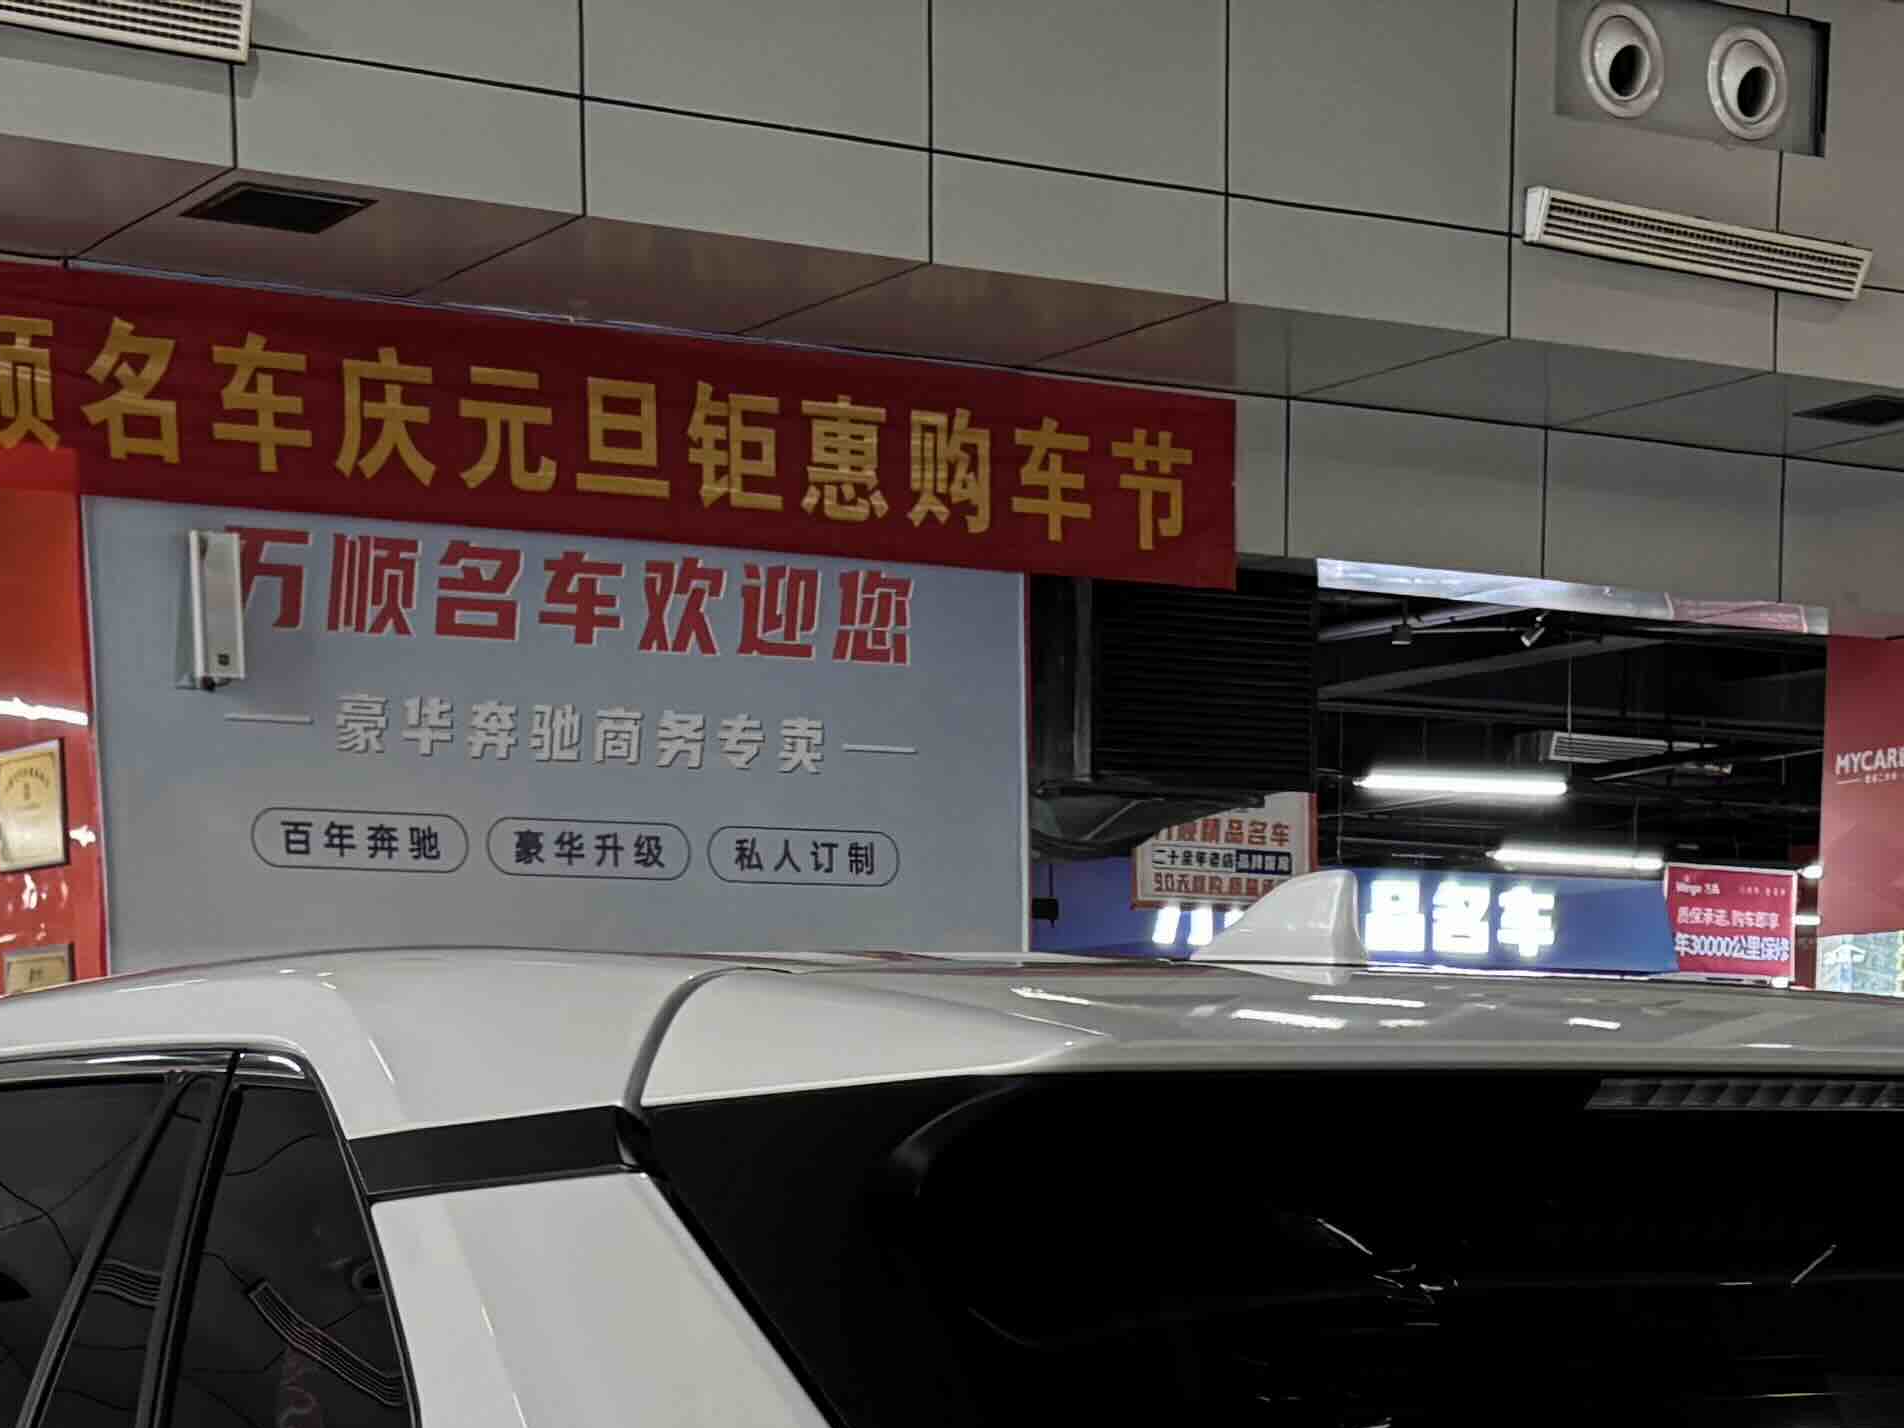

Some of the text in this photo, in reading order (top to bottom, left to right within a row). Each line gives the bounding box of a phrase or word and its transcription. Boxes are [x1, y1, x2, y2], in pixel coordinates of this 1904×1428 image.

[232, 524, 916, 666] 万顺名车欢迎您
[334, 690, 827, 776] 豪华奔驰商务专卖
[280, 819, 877, 877] 百年奔驰 豪华升级 私人订制
